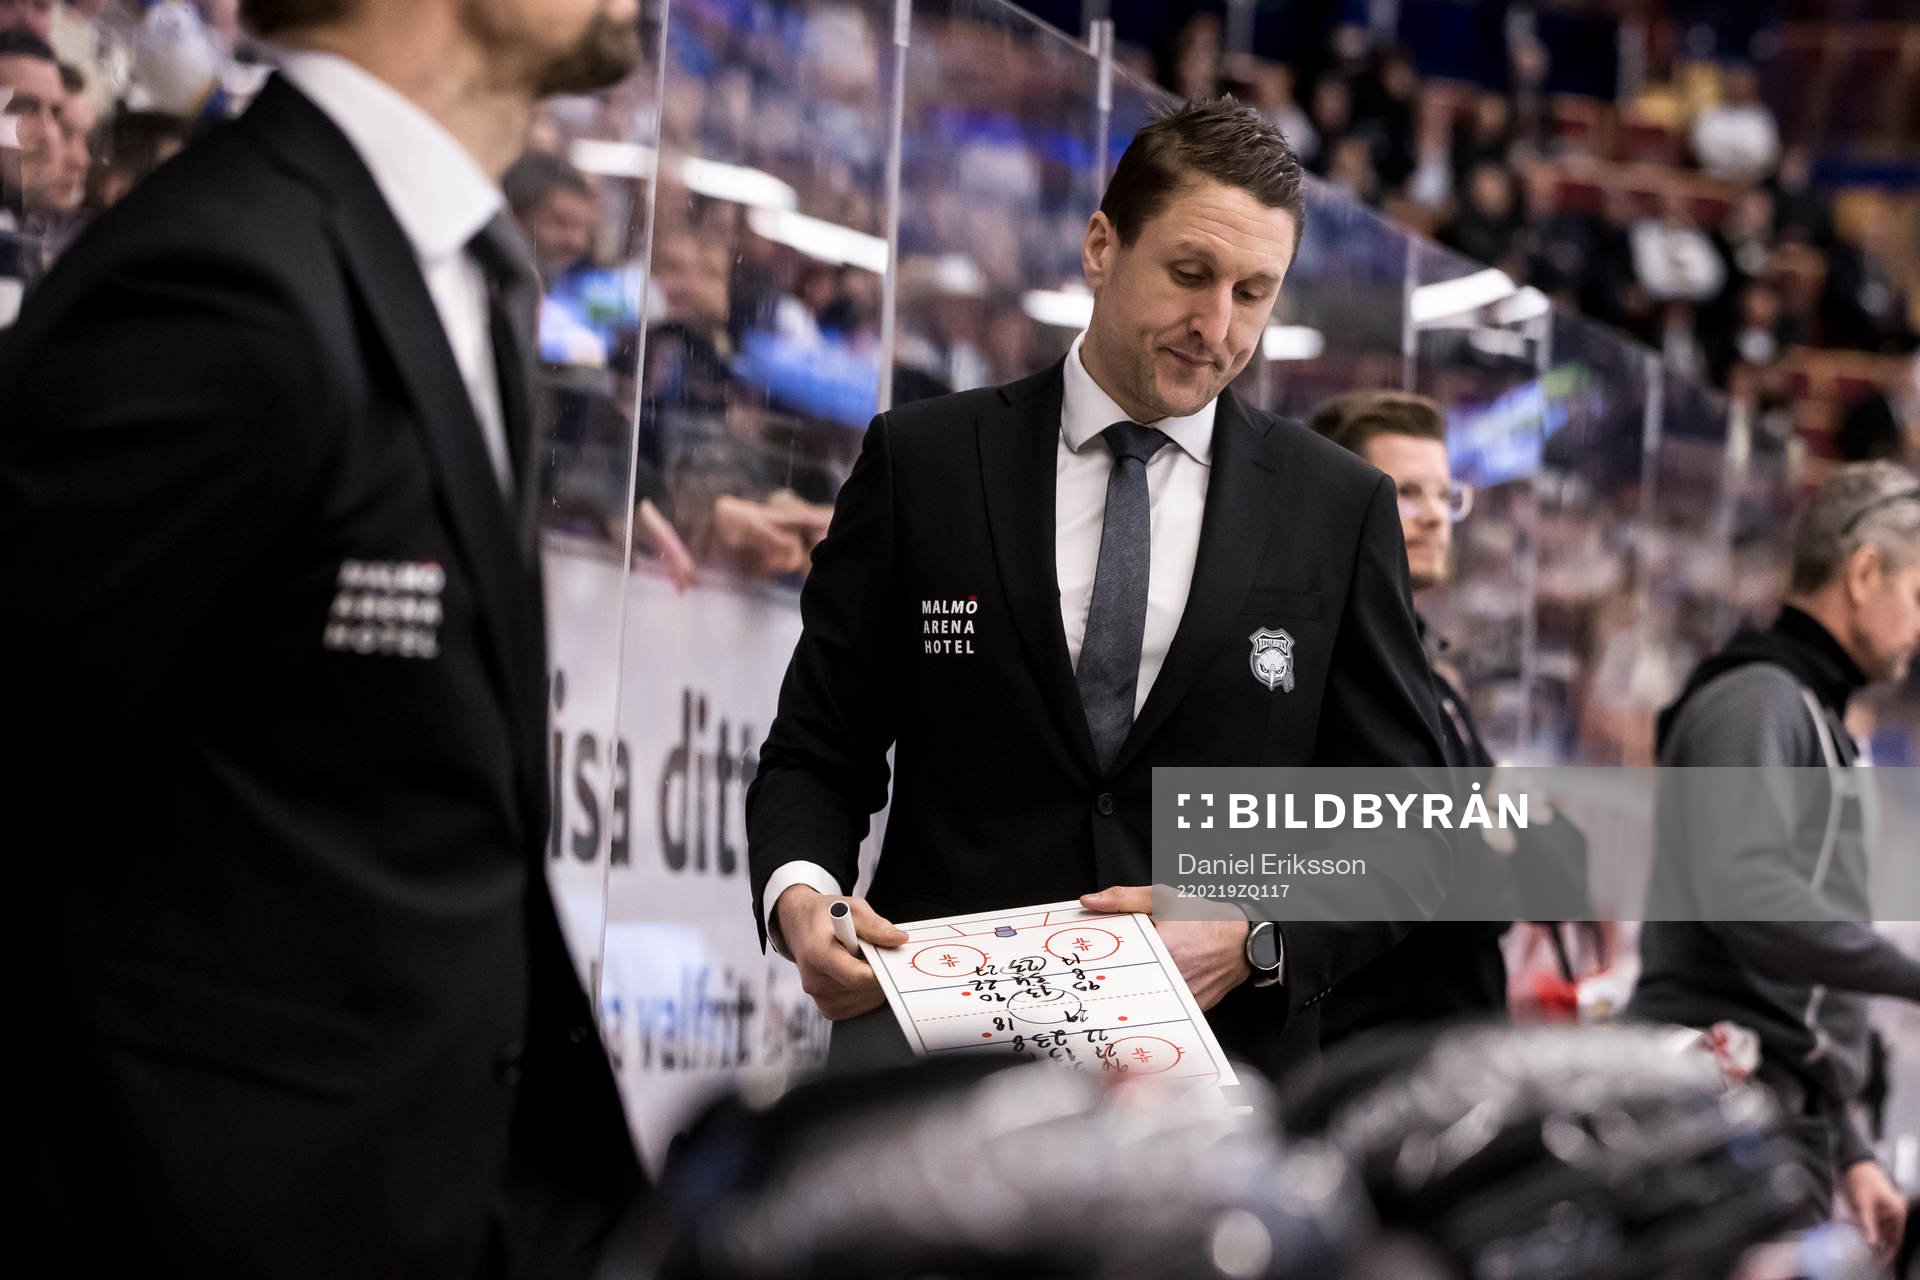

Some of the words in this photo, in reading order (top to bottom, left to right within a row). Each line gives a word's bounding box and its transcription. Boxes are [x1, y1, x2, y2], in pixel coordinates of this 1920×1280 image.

[923, 620, 975, 634] ARENA
[924, 640, 975, 654] HOTEL
[992, 1017, 1014, 1031] 18
